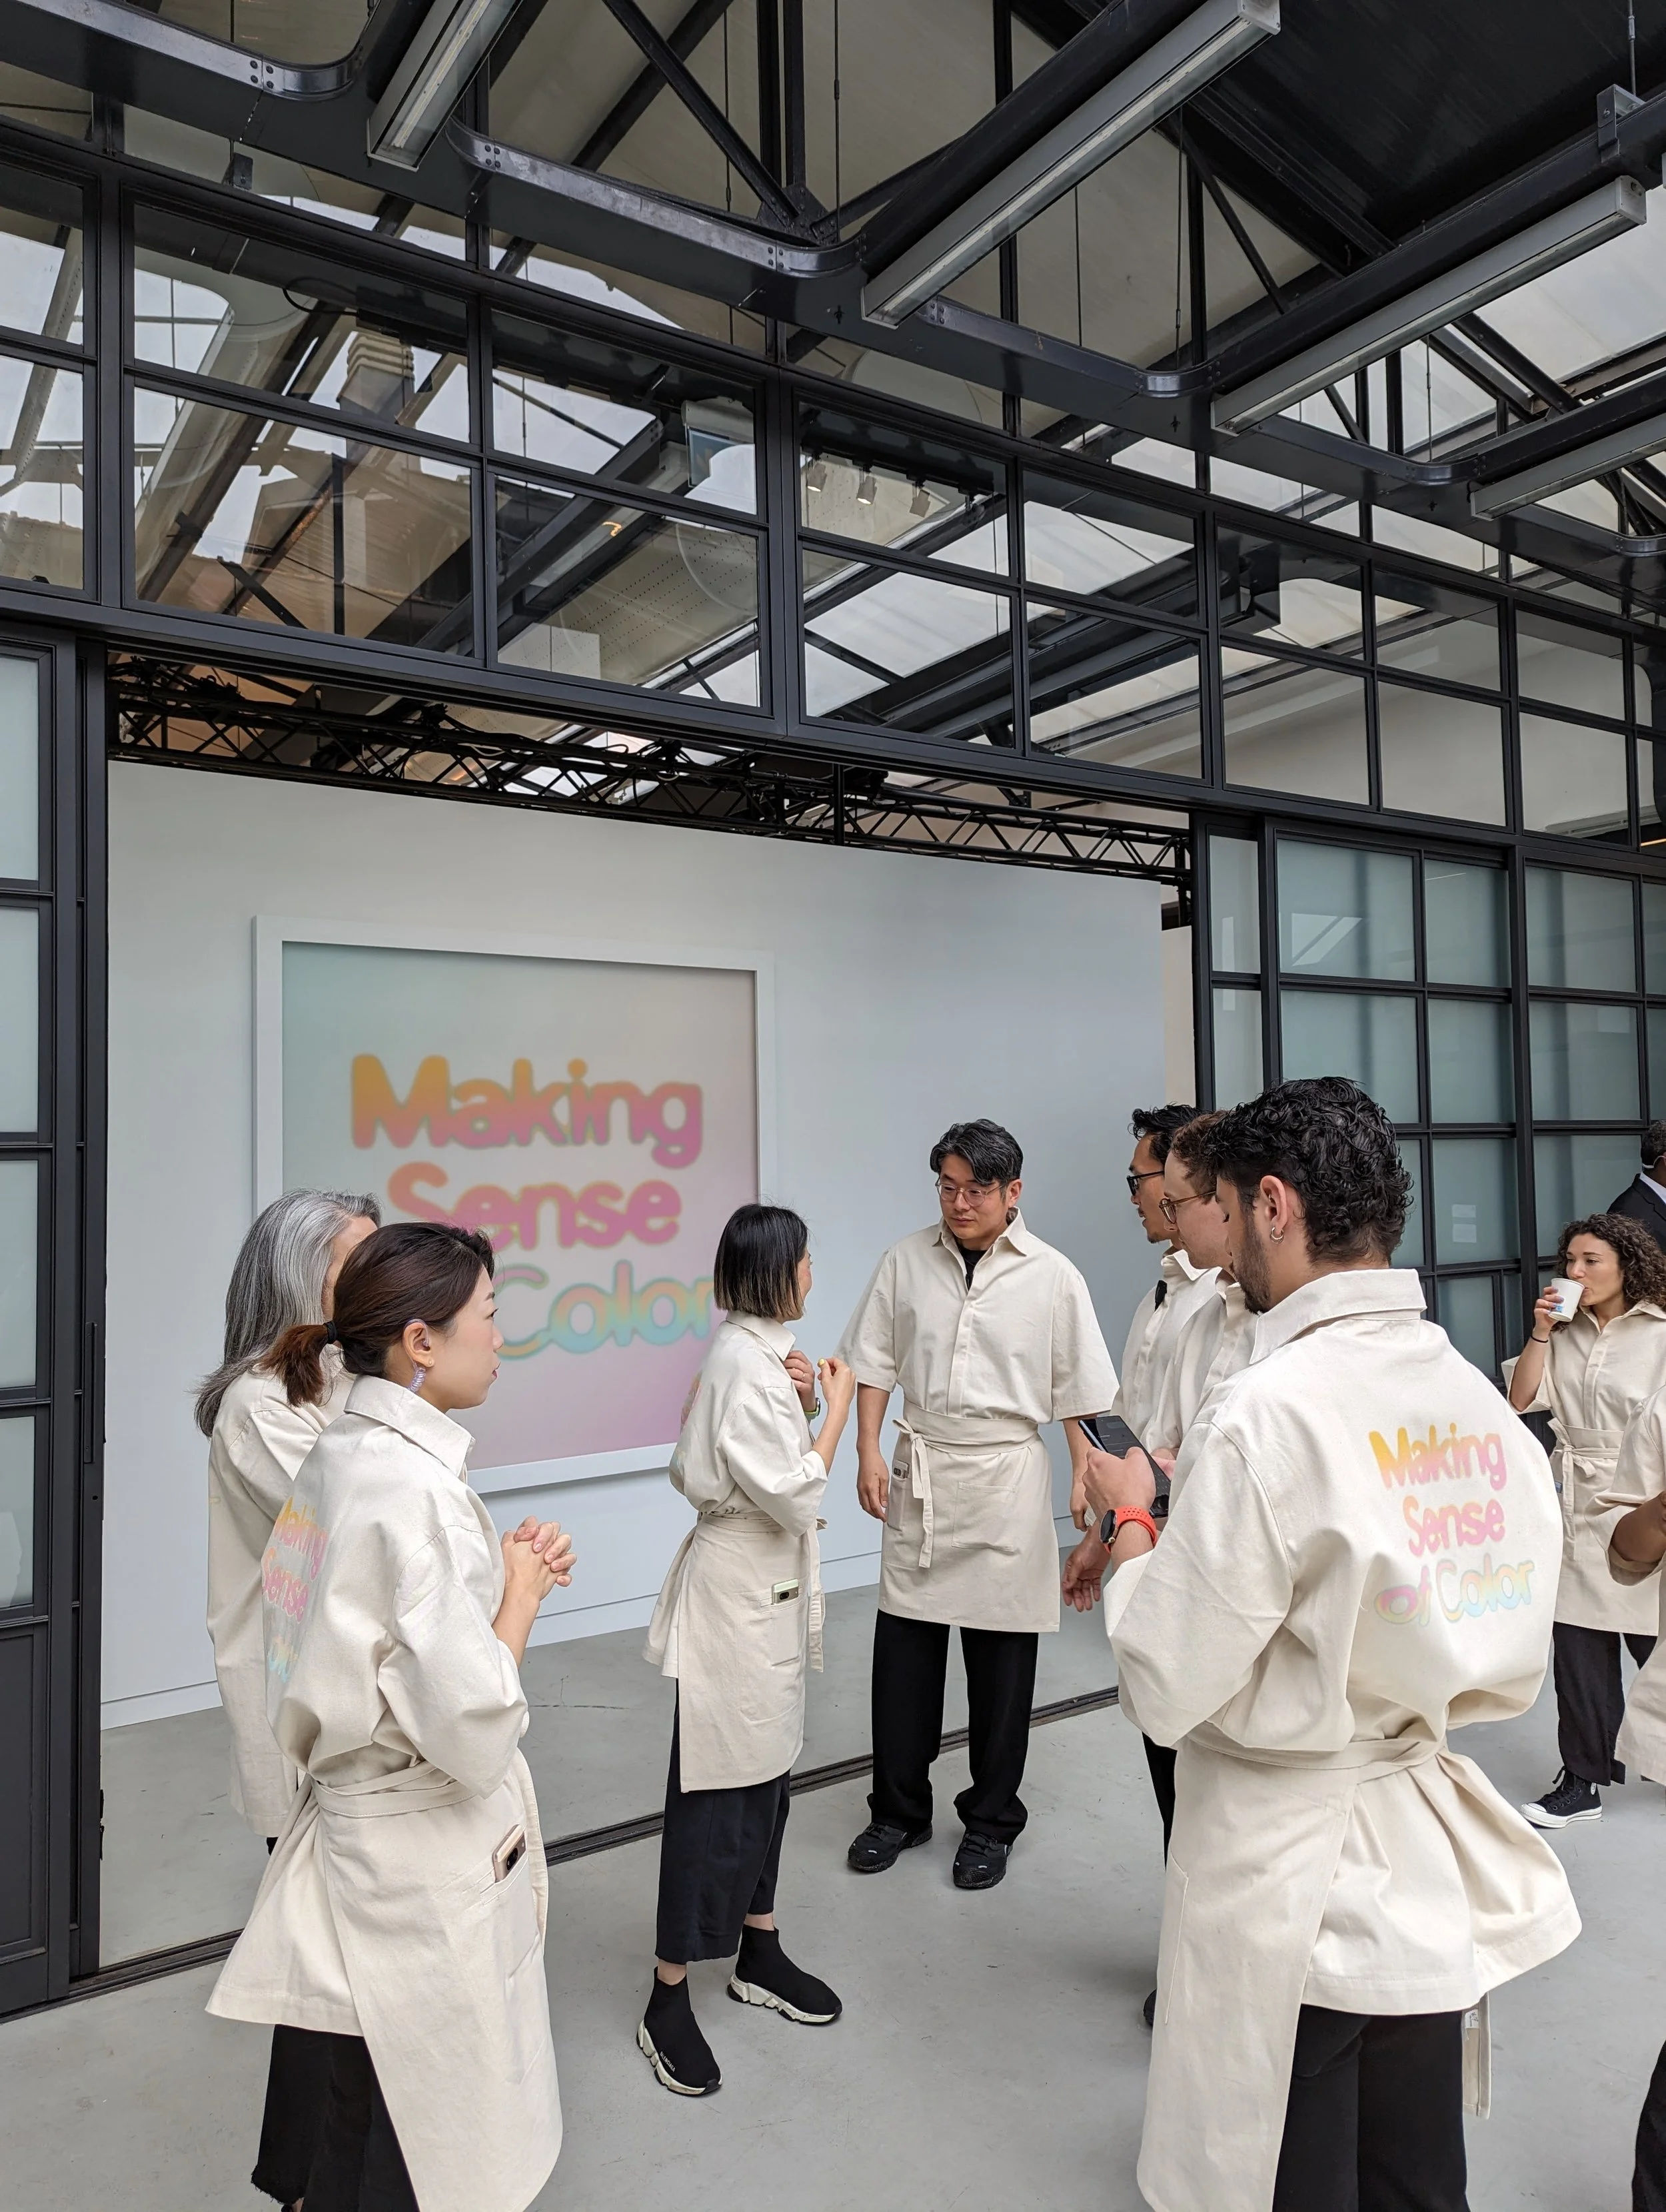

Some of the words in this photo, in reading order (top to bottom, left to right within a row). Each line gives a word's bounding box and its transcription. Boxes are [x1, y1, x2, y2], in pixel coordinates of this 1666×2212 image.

[351, 1053, 704, 1169] Making
[387, 1161, 682, 1250] Sense
[1368, 1422, 1507, 1490] Making
[1402, 1495, 1506, 1558] Sense
[1373, 1564, 1432, 1627] of
[1435, 1552, 1535, 1624] Color
